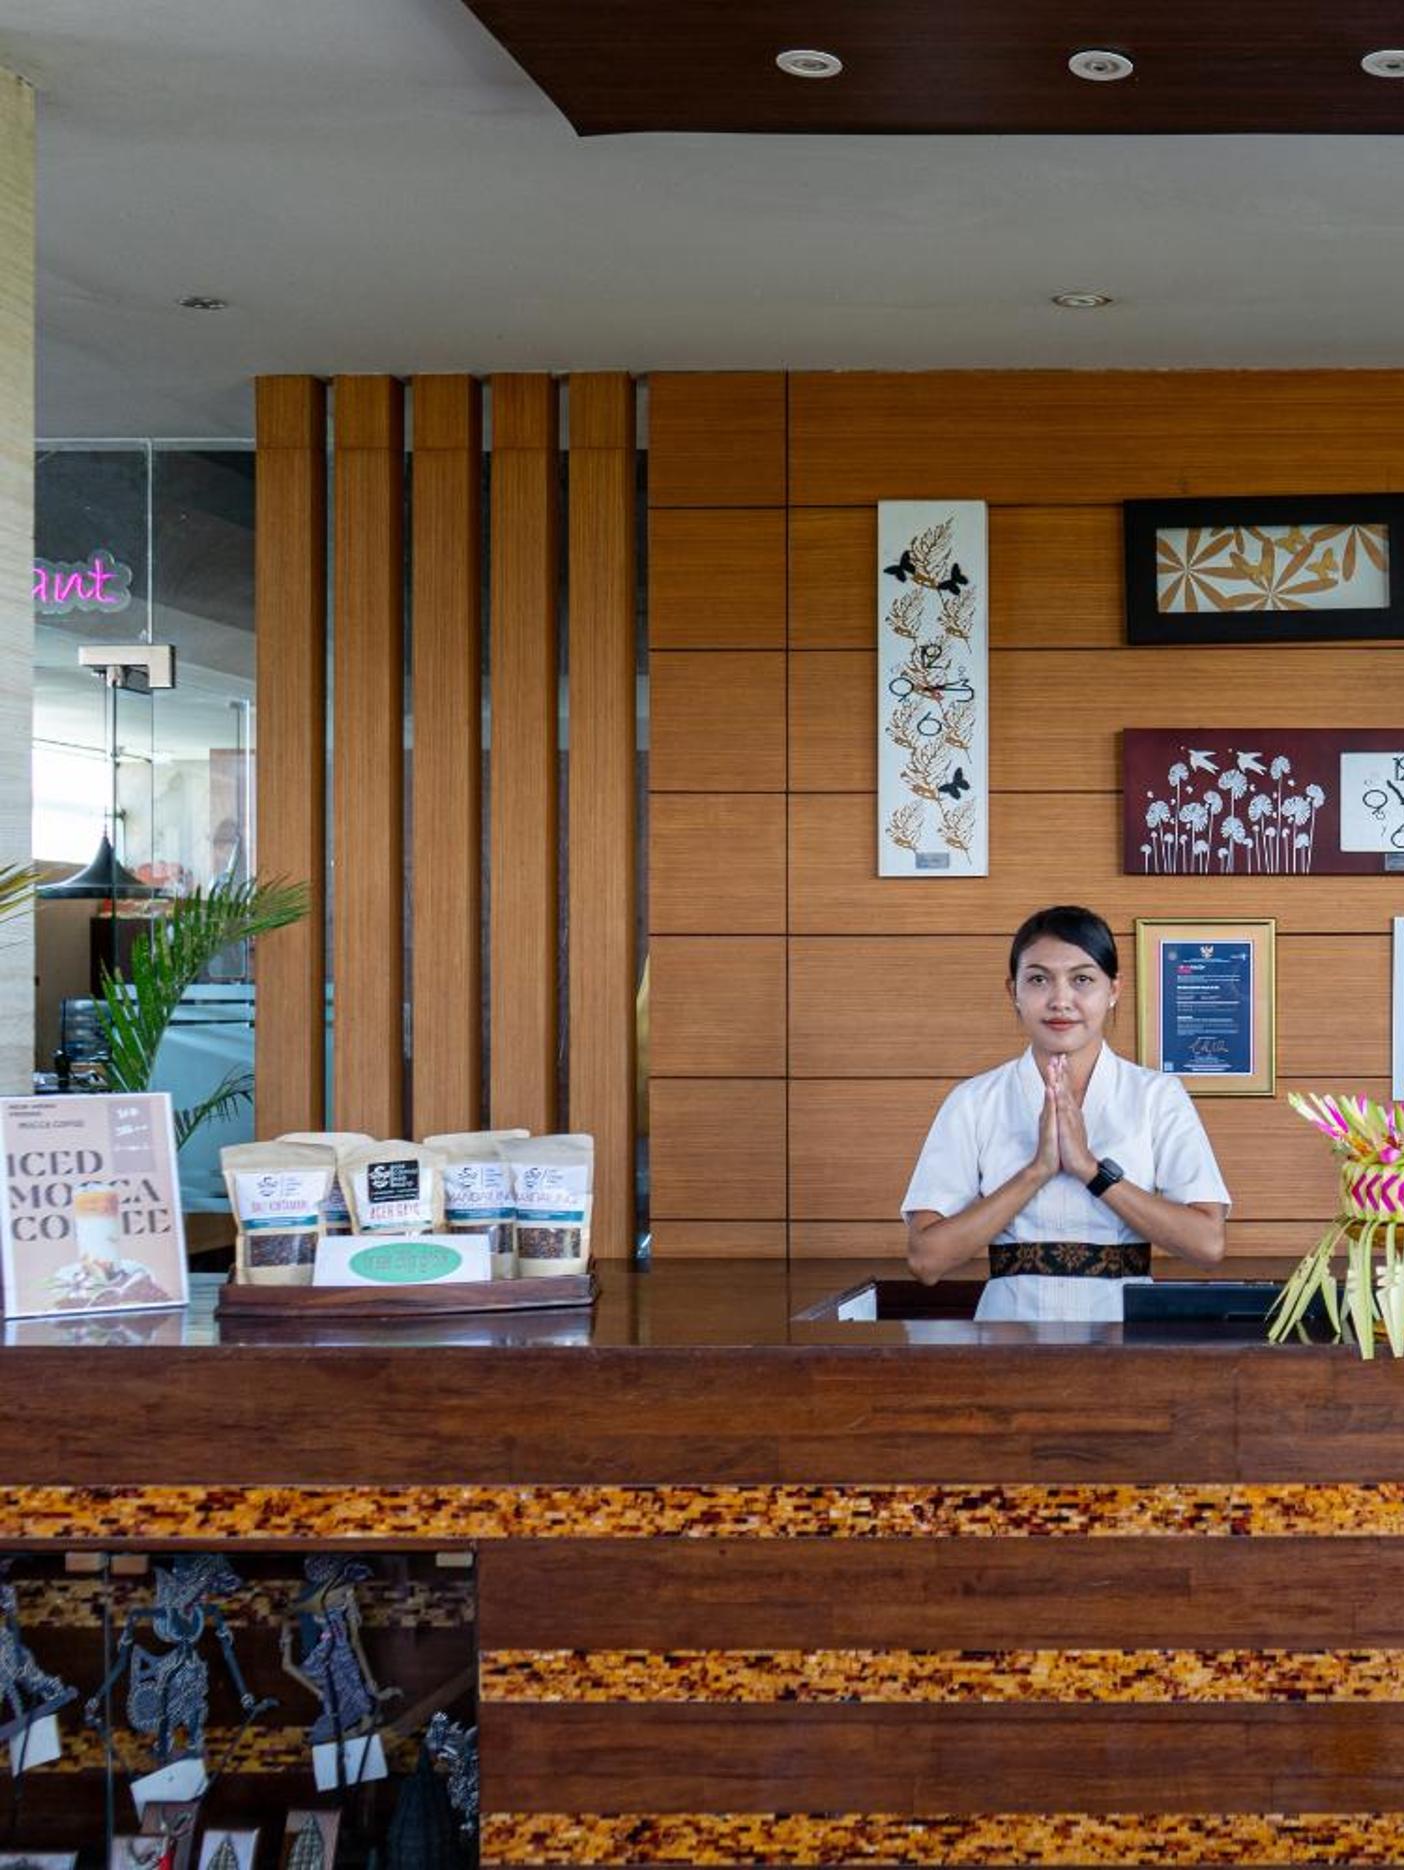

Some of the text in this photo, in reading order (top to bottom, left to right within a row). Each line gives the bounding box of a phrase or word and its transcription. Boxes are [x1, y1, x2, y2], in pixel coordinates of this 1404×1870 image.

[919, 643, 942, 668] 12
[889, 677, 914, 702] 9
[956, 679, 974, 702] 3
[917, 711, 942, 736] 6
[1363, 789, 1388, 815] 9
[7, 1150, 104, 1178] ICED
[9, 1179, 161, 1210] MOA
[11, 1208, 172, 1241] COEE
